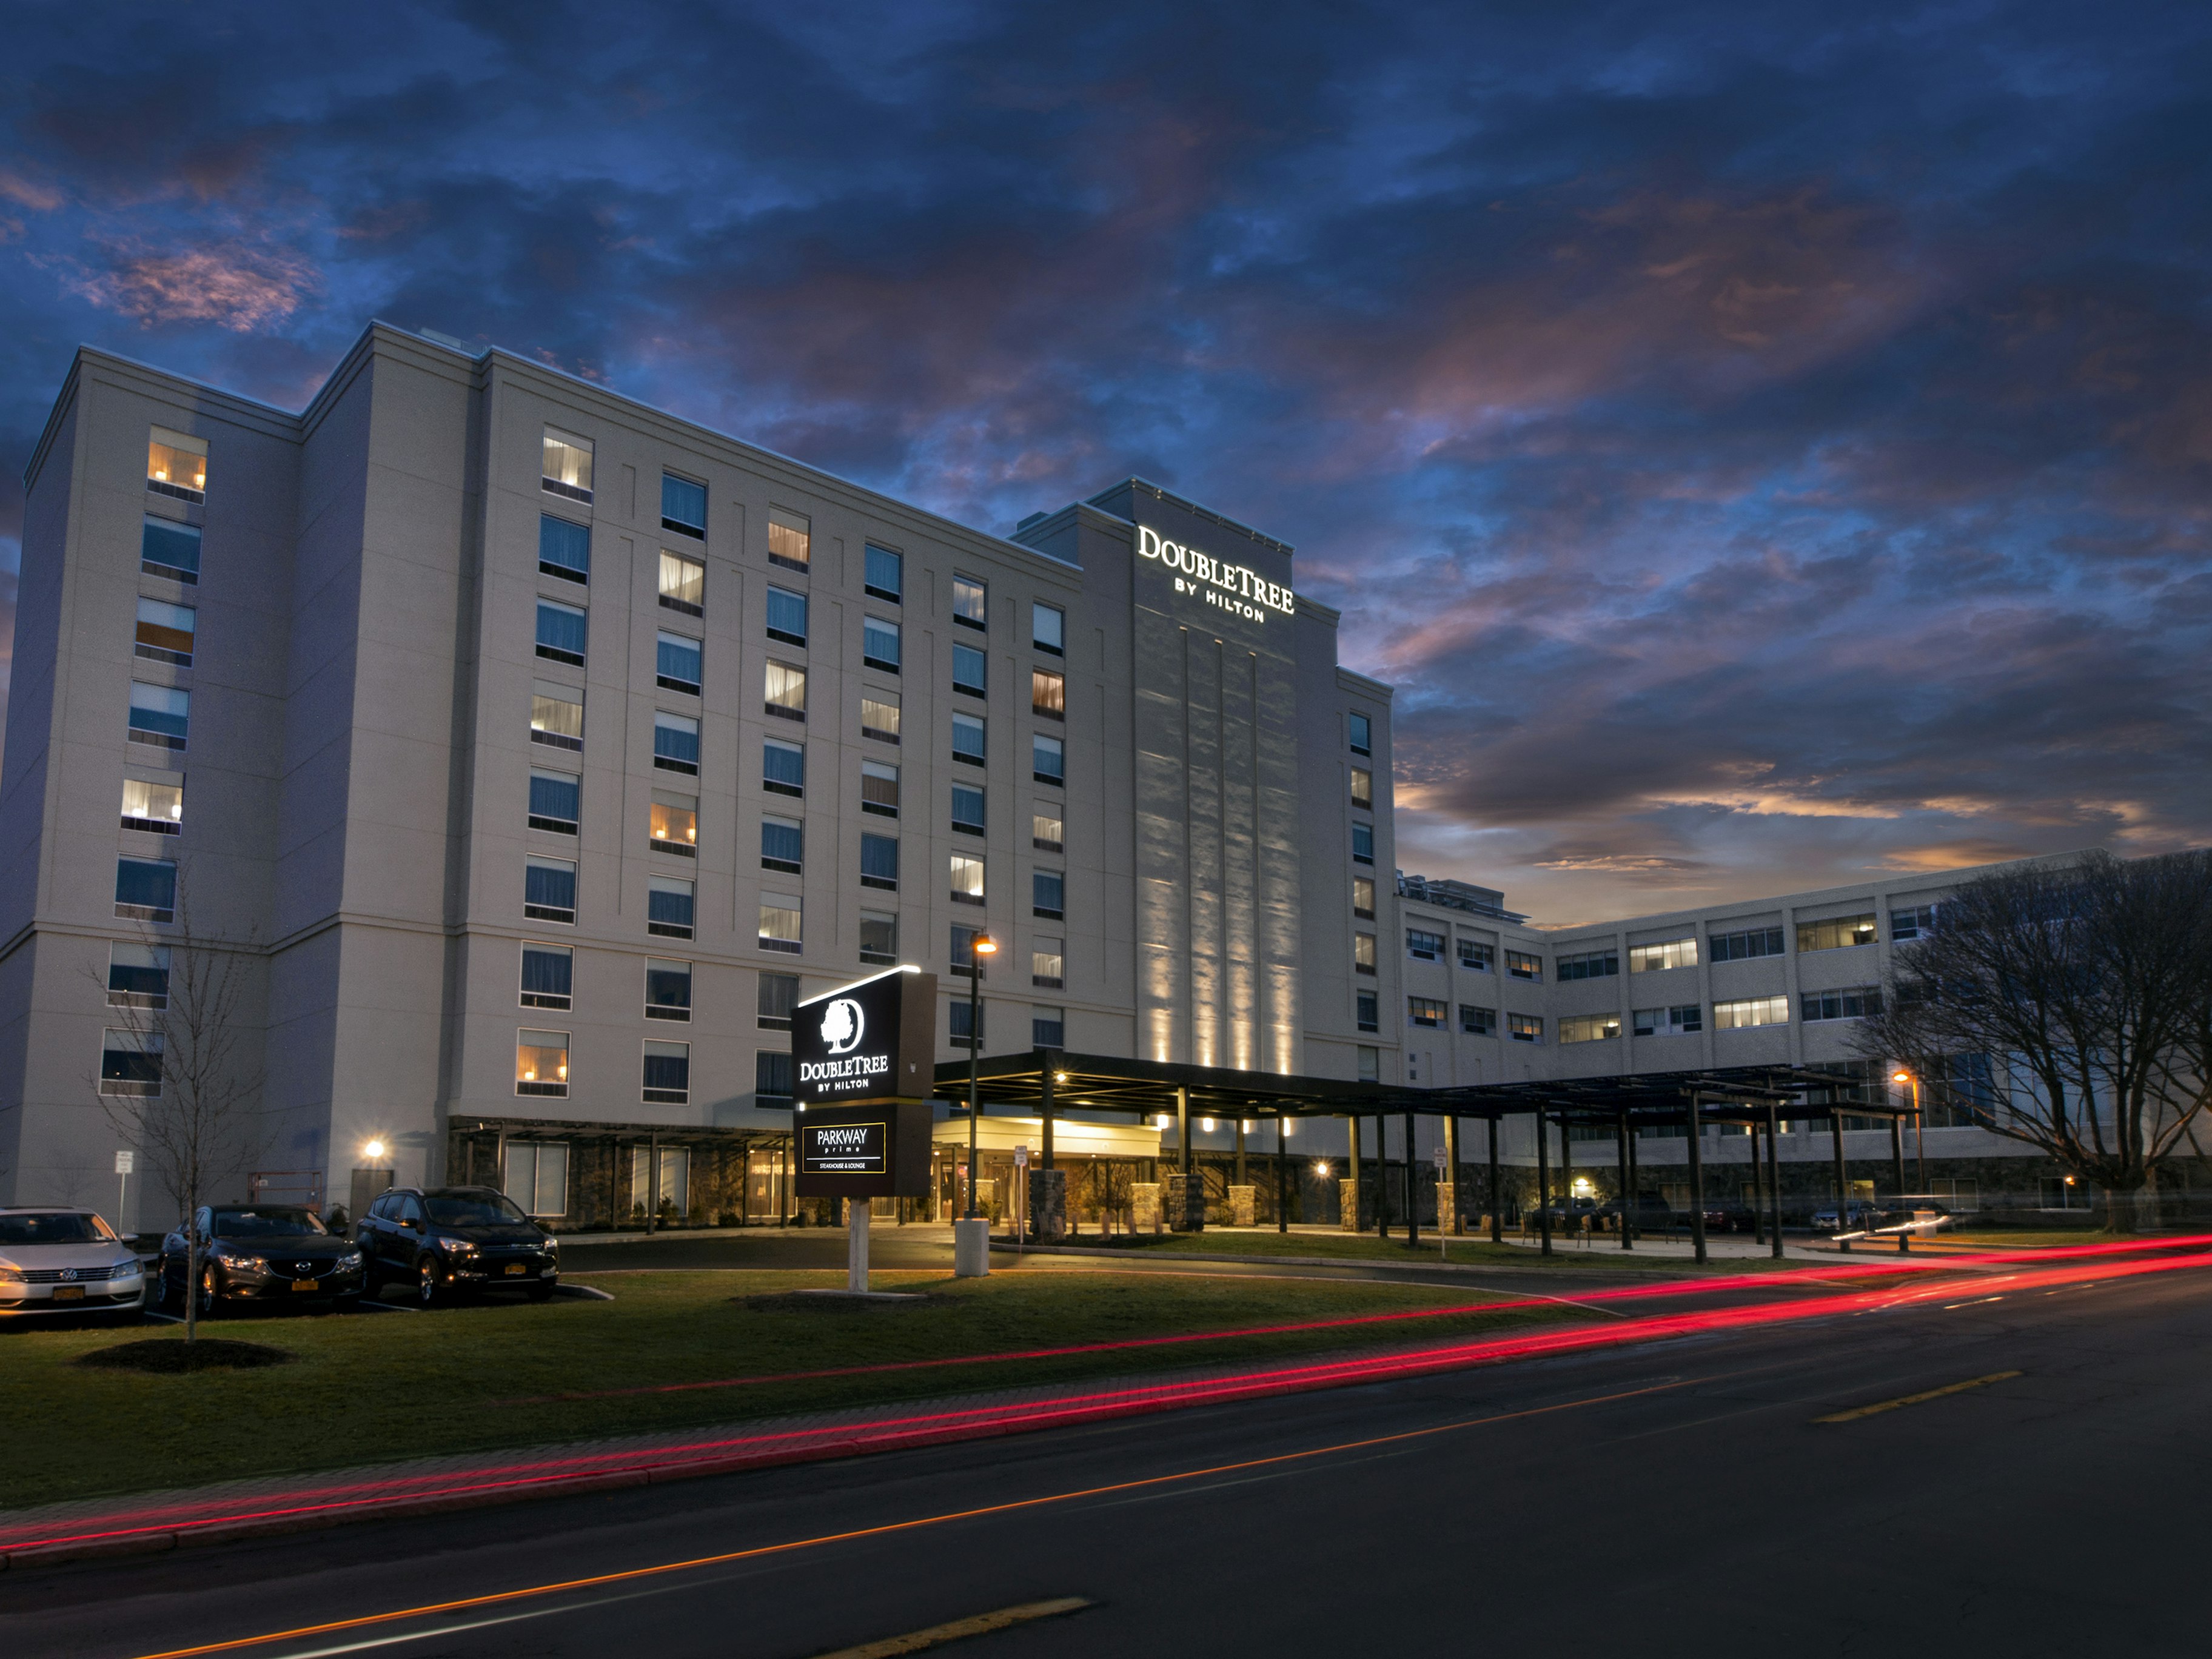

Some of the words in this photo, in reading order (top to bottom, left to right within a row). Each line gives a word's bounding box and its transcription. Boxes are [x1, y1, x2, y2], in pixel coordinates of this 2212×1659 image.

[1175, 577, 1197, 595] BY
[1206, 590, 1264, 623] HILTON
[818, 1083, 830, 1092] BY
[834, 1079, 869, 1090] HILTON
[817, 1128, 867, 1145] PARKWAY
